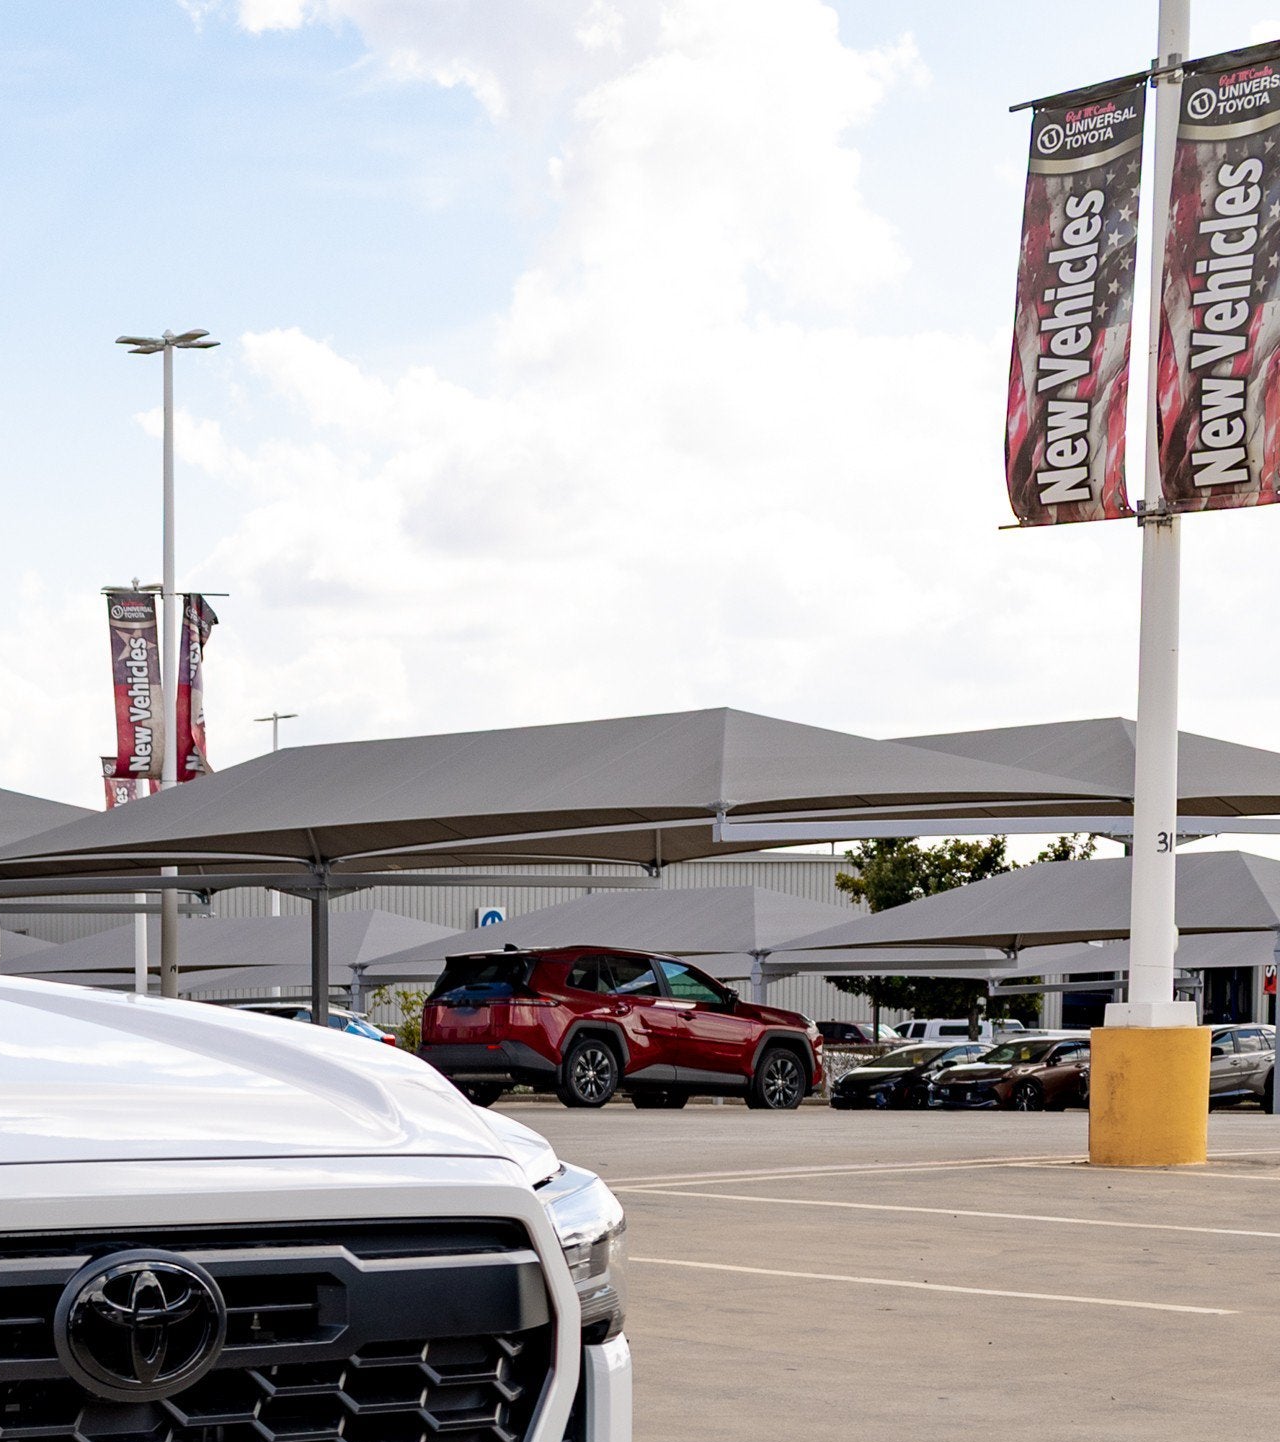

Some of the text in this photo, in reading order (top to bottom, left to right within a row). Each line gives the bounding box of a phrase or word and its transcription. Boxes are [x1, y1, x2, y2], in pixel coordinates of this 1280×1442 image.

[1220, 74, 1280, 100] UNIVERS
[1217, 92, 1270, 115] TOYOTA
[1066, 106, 1137, 135] UNIVERSAL
[1065, 127, 1114, 150] TOYOTA
[1191, 157, 1264, 488] New Vehicles
[1037, 188, 1105, 505] New Vehicles
[127, 637, 151, 772] New Vehicles
[1157, 831, 1173, 853] 31
